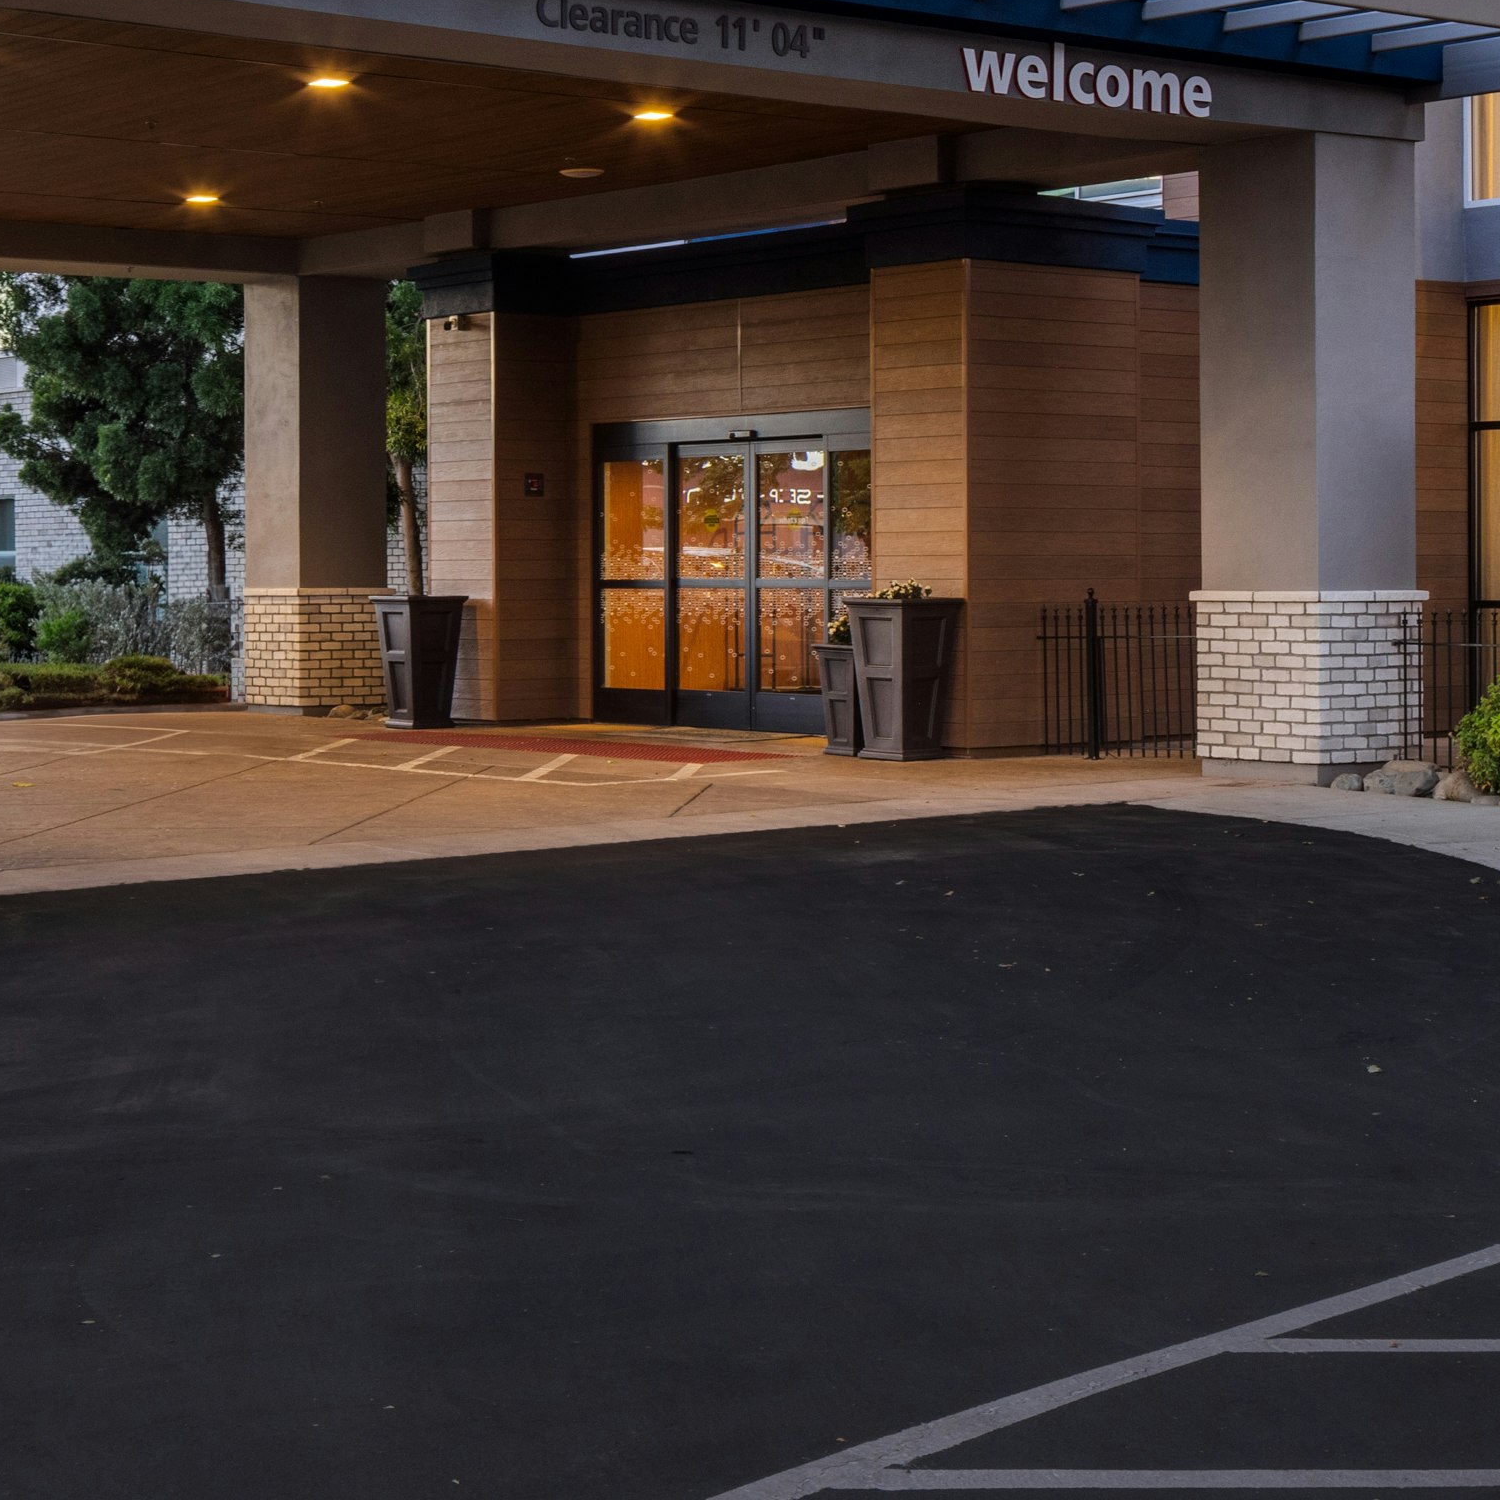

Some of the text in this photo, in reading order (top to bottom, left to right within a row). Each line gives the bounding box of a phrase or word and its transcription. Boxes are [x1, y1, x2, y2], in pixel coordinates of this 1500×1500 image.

[715, 14, 760, 51] 11'
[771, 22, 825, 58] 04"
[961, 42, 1213, 118] welcome
